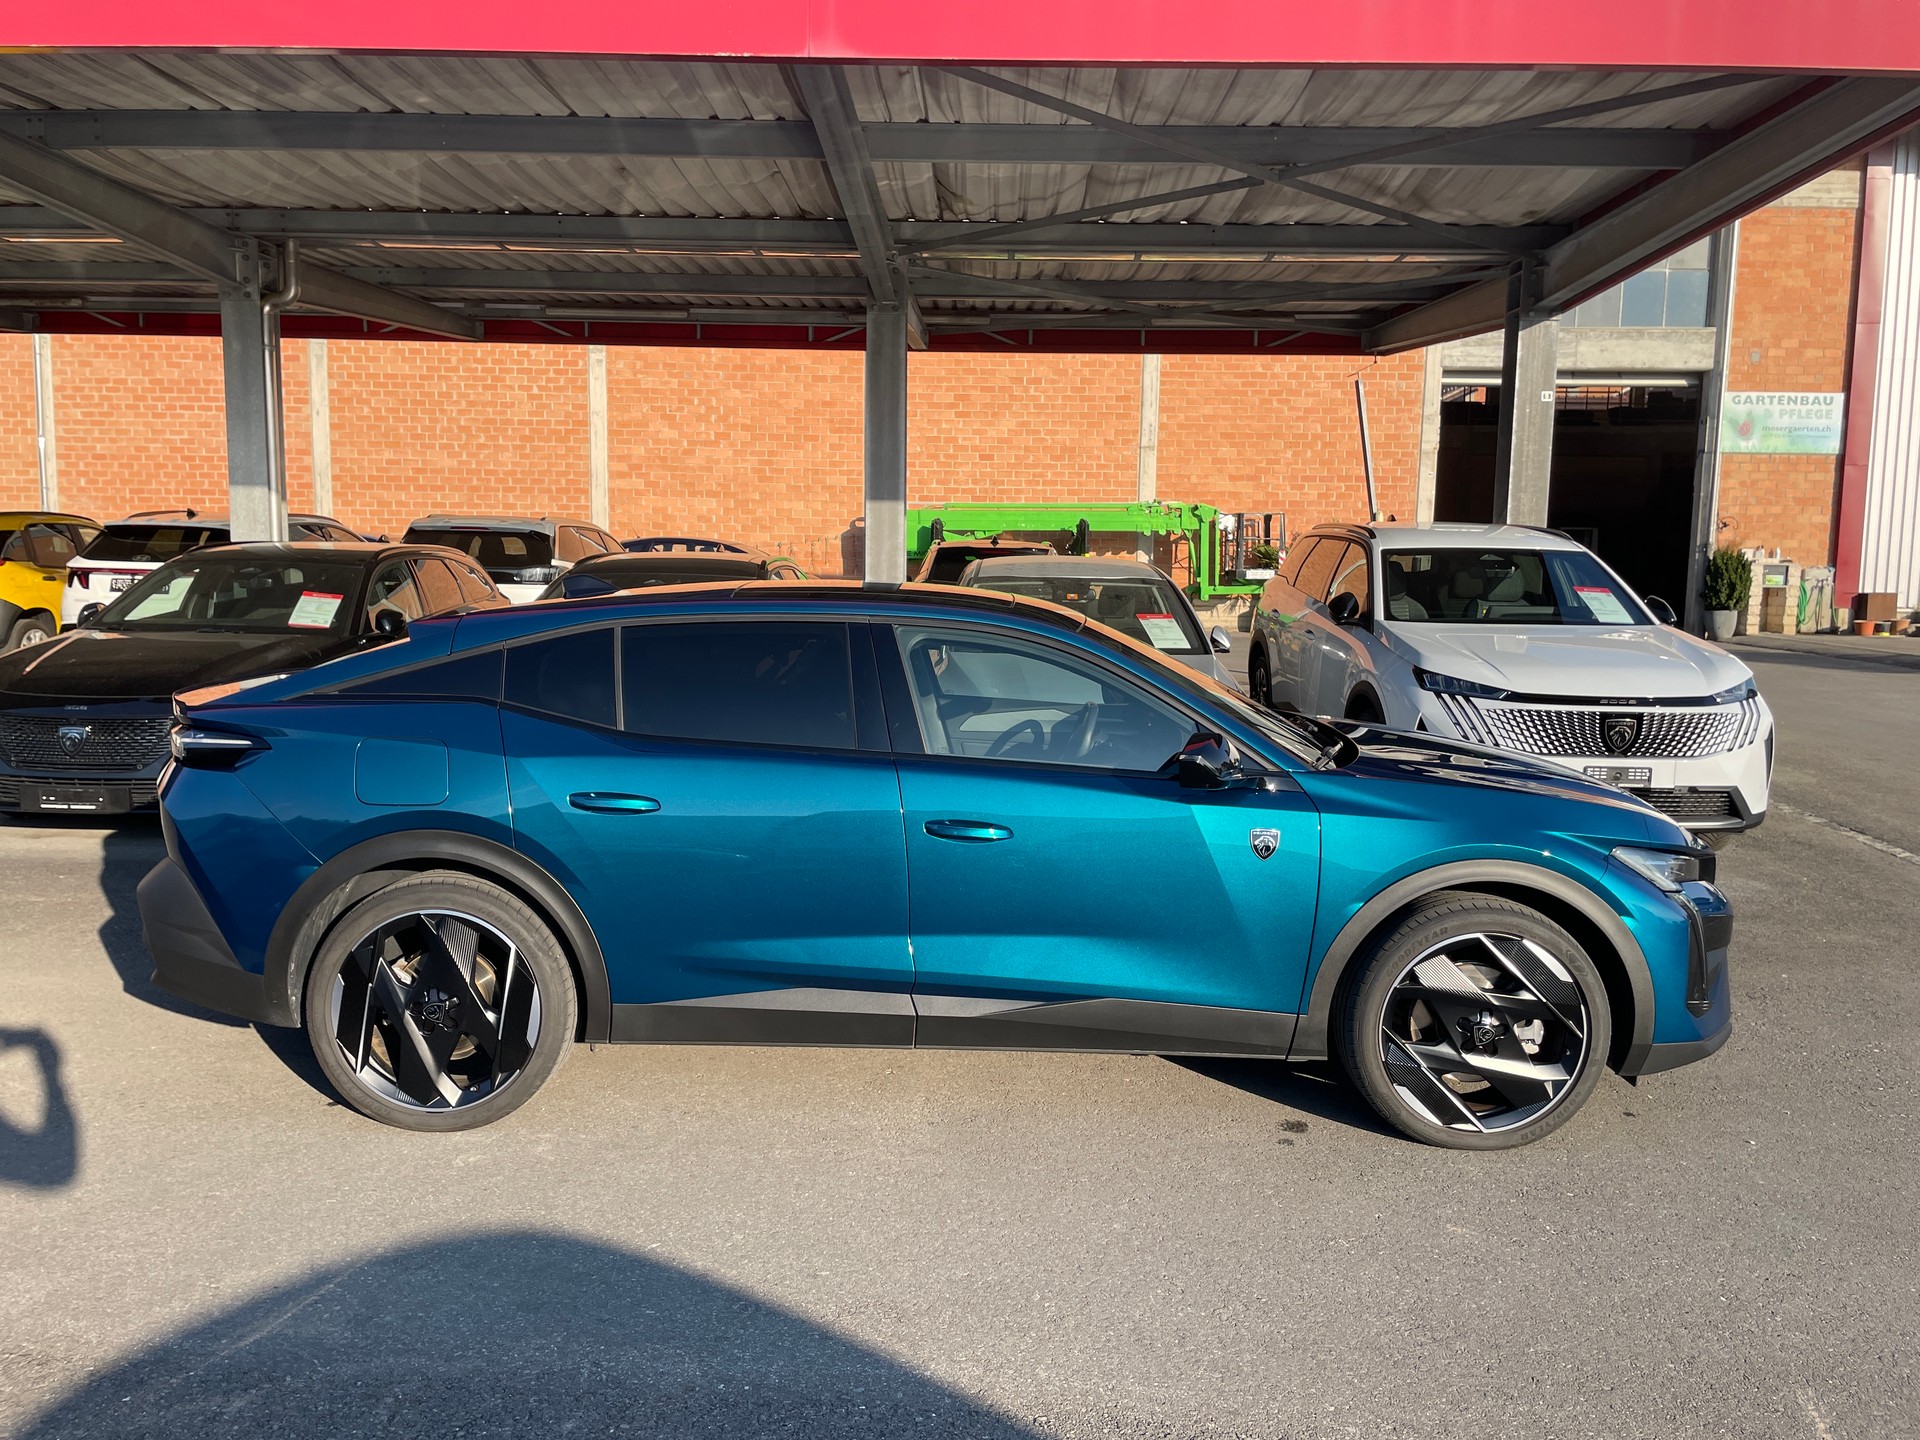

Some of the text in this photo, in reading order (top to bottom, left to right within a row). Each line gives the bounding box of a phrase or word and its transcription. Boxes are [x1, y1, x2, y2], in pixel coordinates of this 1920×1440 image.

[1732, 395, 1834, 406] GARTENBAU
[1778, 408, 1833, 420] PFLEGE
[1762, 425, 1832, 434] mosergaerten.ch
